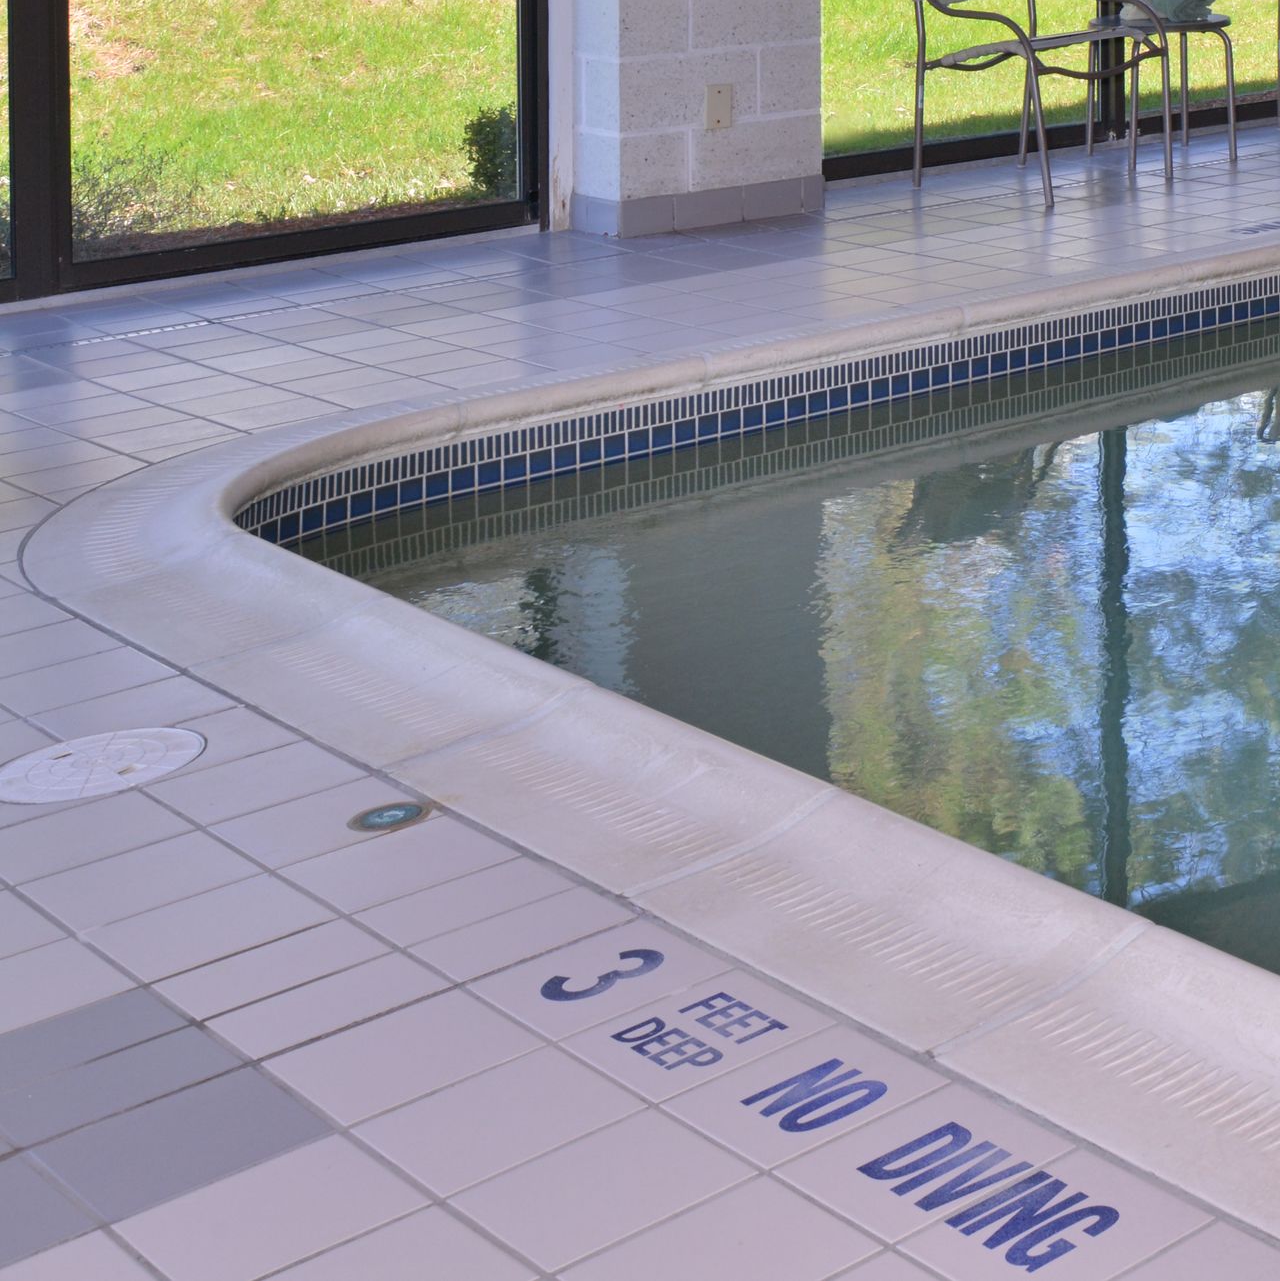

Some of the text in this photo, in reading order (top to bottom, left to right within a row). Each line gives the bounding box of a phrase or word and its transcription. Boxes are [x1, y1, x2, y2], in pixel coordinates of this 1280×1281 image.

[540, 948, 664, 1002] 3
[610, 1016, 724, 1071] DEEP
[678, 991, 788, 1045] FEET
[739, 1057, 1120, 1274] NO DIVING
